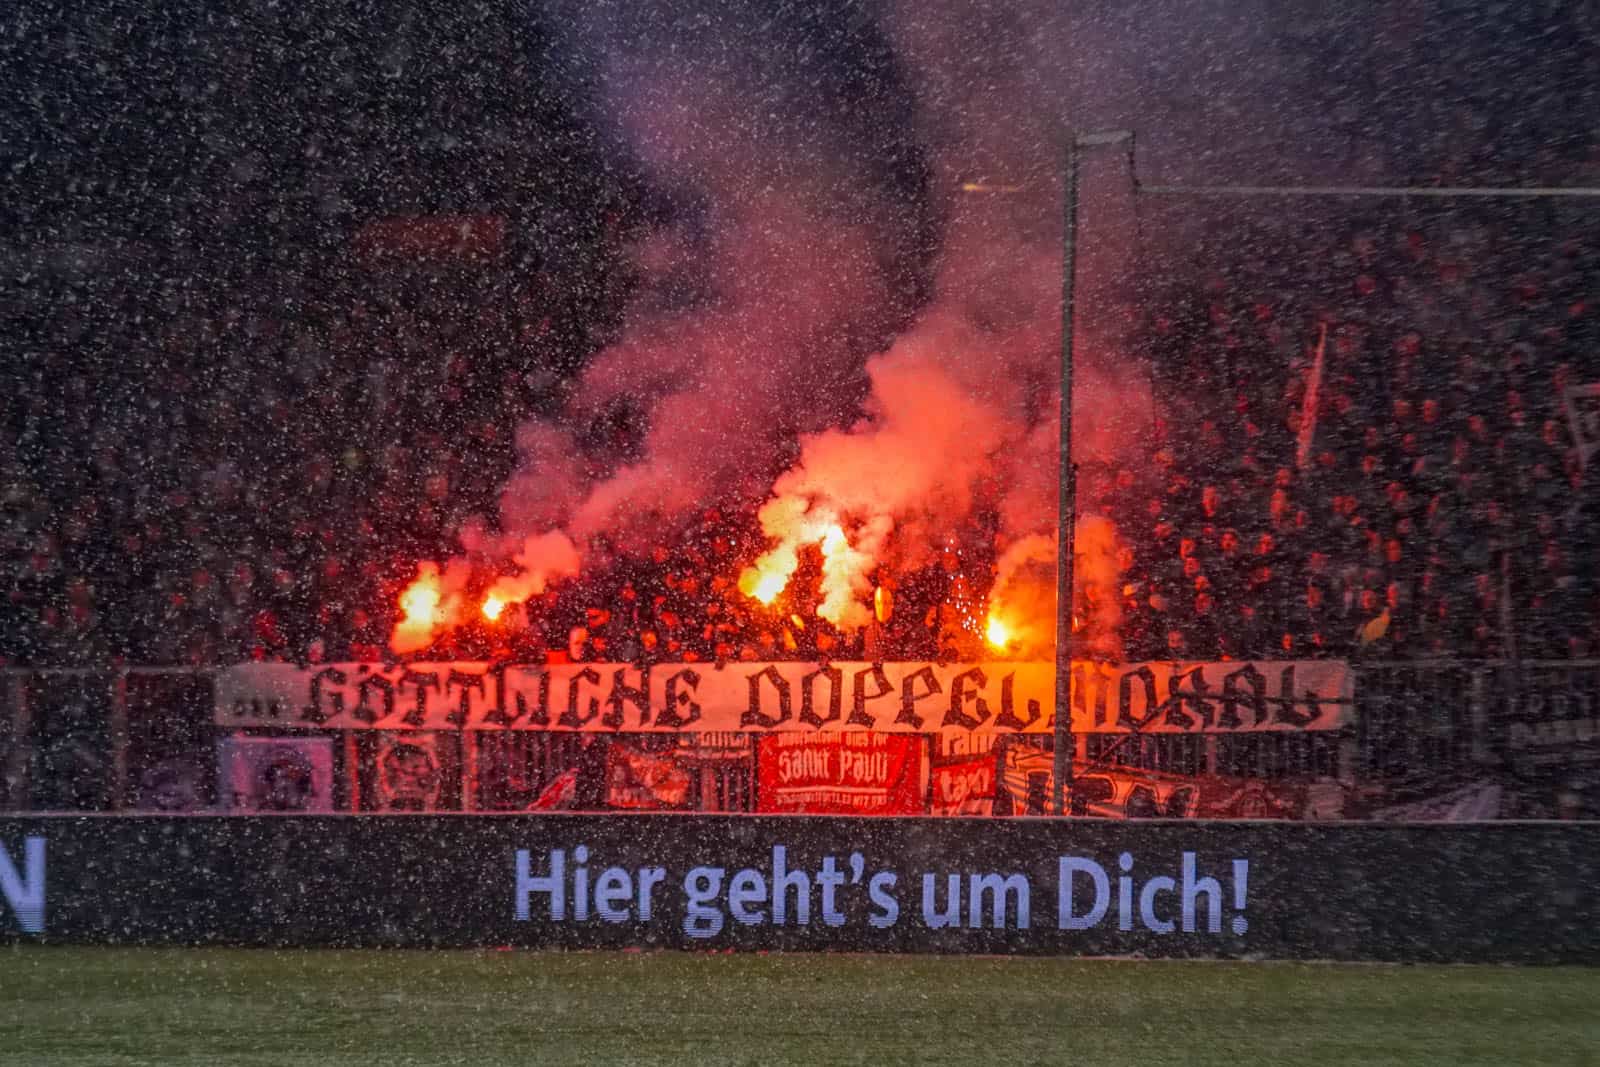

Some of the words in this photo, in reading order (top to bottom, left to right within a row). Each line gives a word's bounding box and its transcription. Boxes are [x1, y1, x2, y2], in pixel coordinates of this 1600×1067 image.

[514, 845, 665, 921] Hier
[922, 873, 1031, 929] um
[1058, 852, 1249, 934] Dich!
